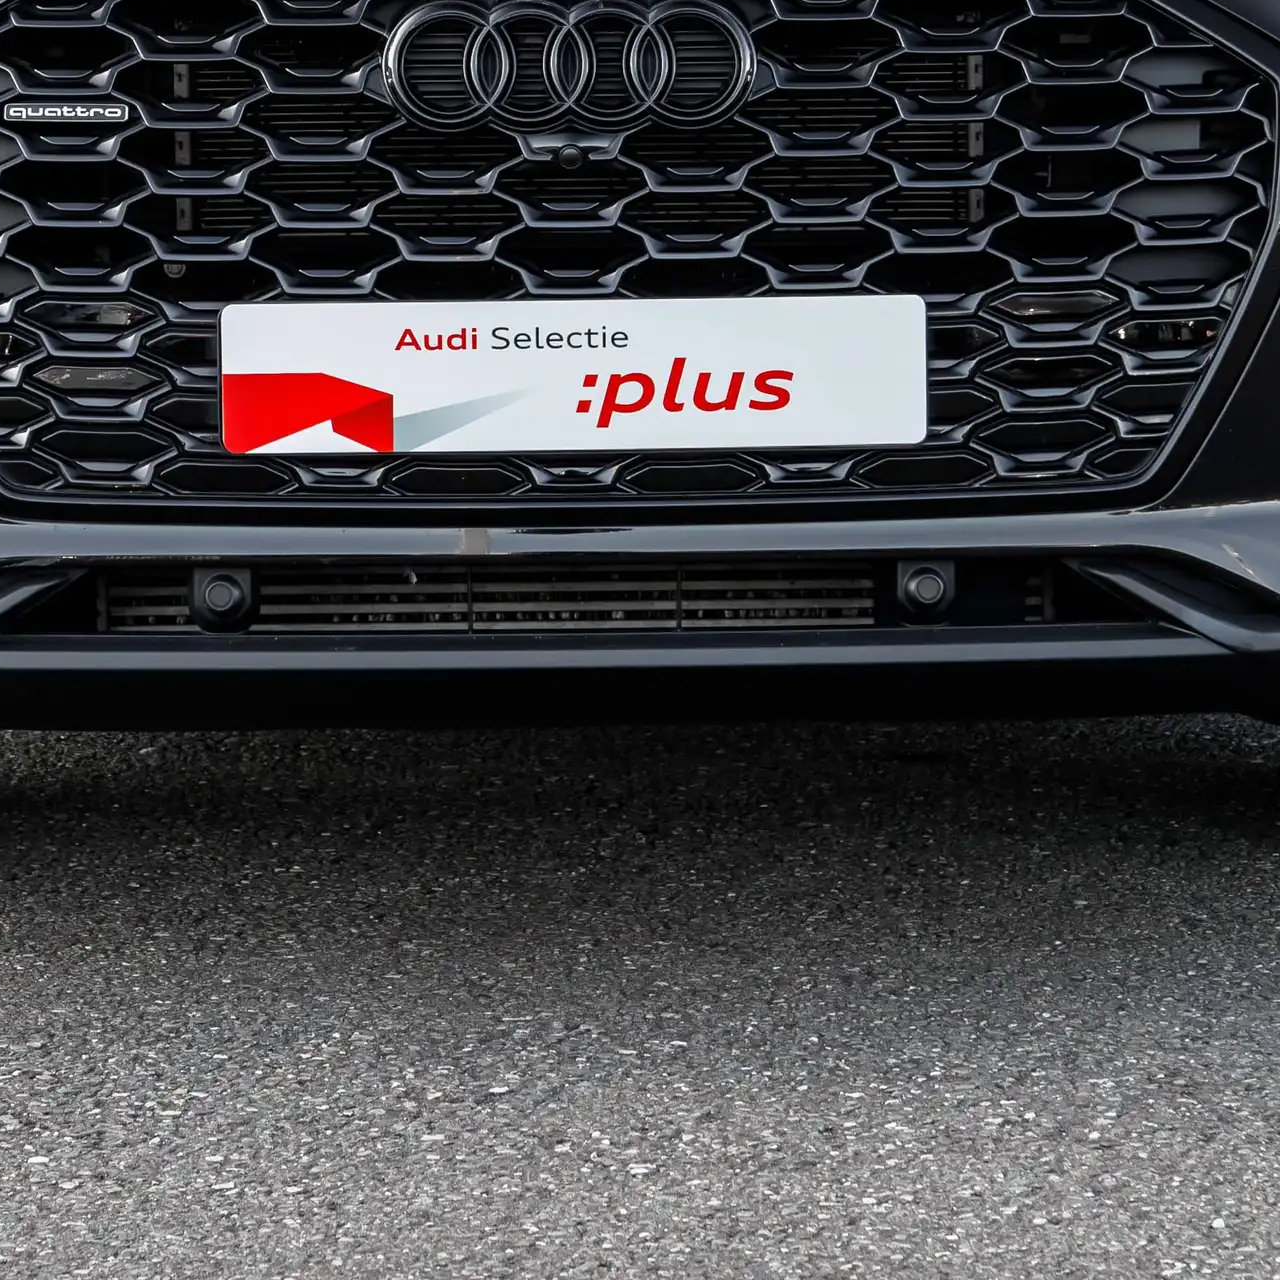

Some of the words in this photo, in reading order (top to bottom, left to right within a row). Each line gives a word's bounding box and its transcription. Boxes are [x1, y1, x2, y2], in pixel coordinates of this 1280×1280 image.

[9, 106, 122, 119] quattro
[394, 327, 479, 351] Audi
[490, 325, 630, 350] Selectie
